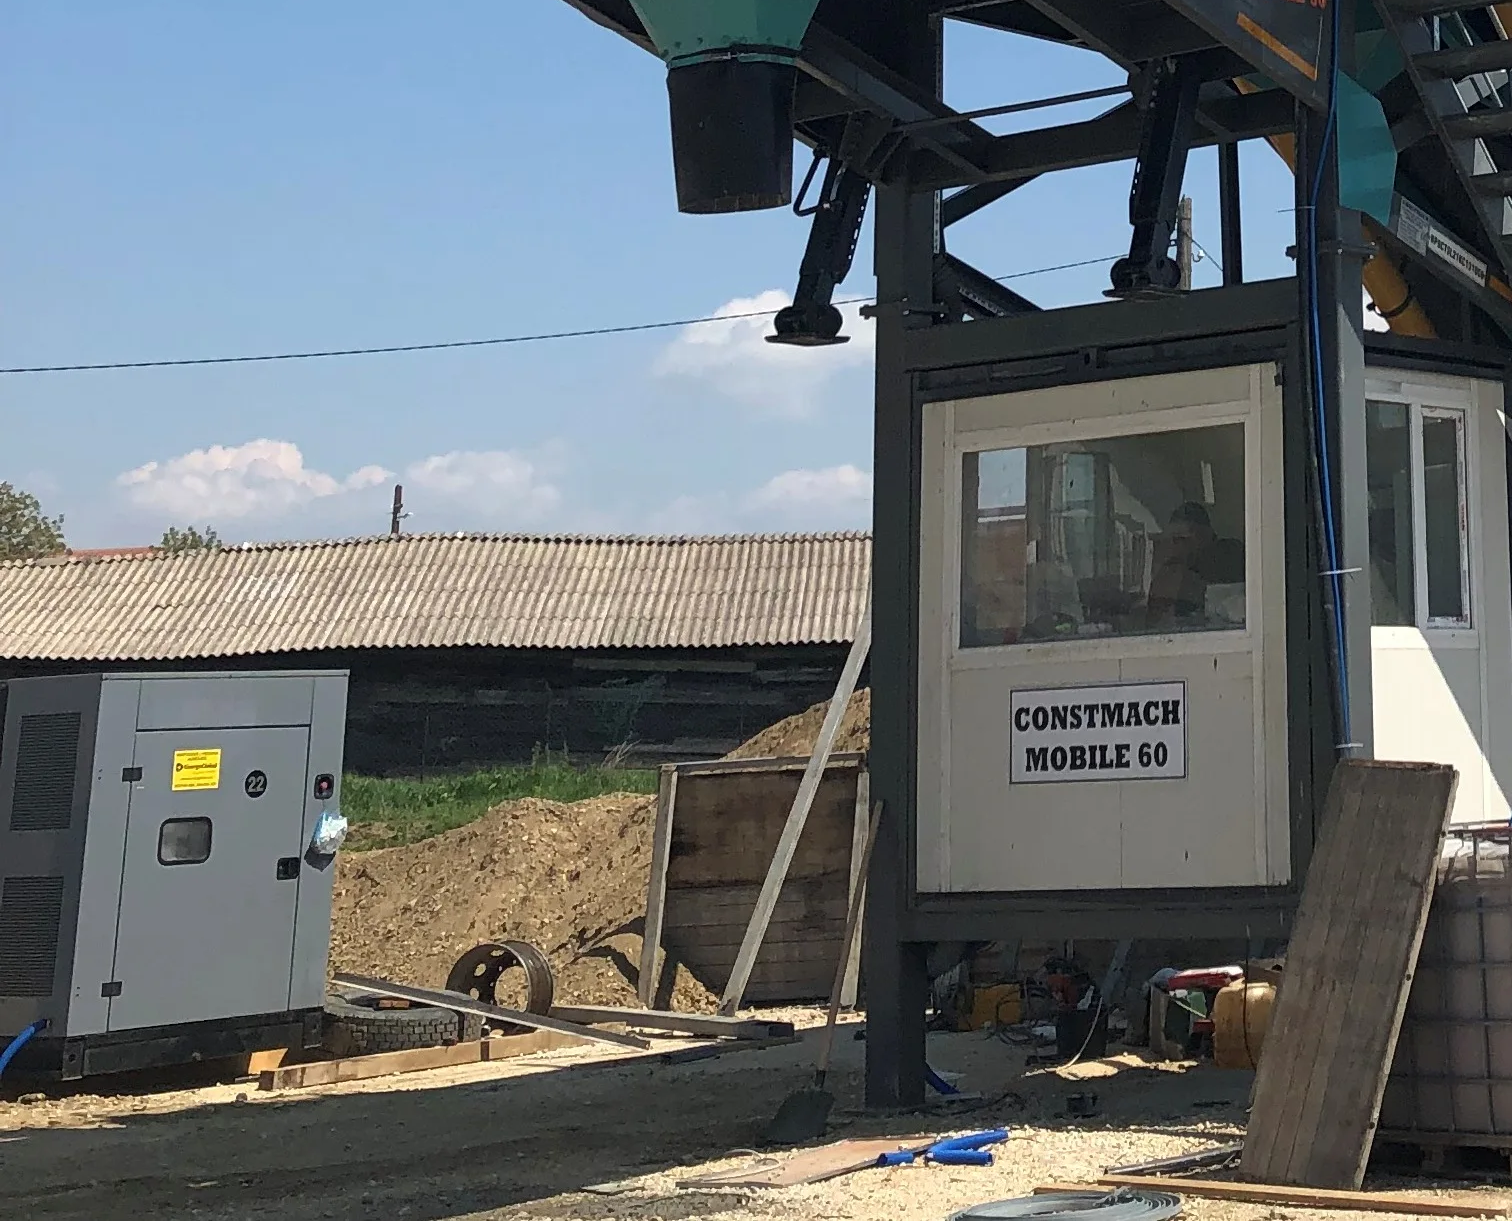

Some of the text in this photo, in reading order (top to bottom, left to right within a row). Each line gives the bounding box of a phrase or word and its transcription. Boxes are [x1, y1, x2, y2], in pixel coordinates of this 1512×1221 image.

[1014, 699, 1181, 732] CONSTMACH
[1025, 741, 1168, 772] MOBILE 60
[248, 775, 265, 793] 22
